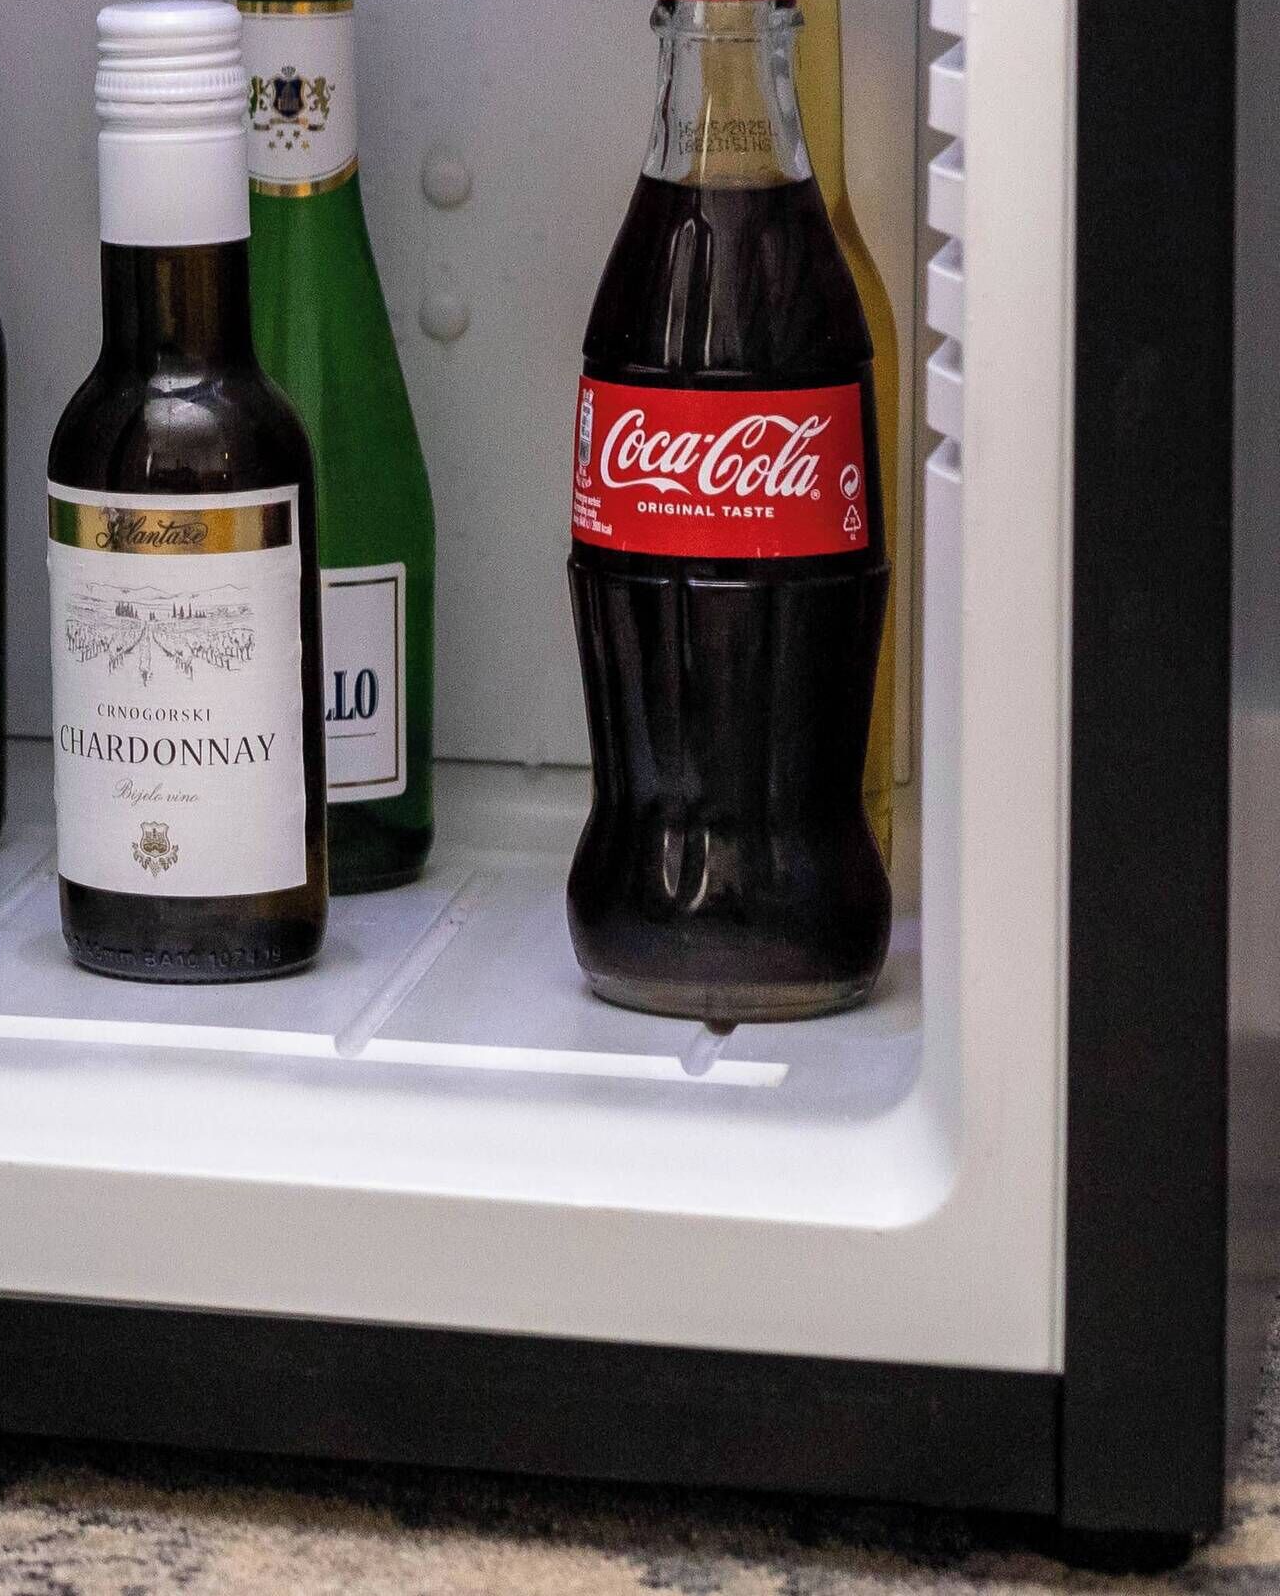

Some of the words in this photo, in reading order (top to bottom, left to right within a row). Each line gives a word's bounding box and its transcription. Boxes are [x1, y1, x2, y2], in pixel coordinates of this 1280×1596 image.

[600, 408, 832, 498] Coca-Cola
[637, 500, 715, 517] ORIGINAL
[721, 506, 775, 519] TASTE
[97, 703, 212, 723] CRNOGORSKI
[59, 723, 276, 767] CHARDONNAY
